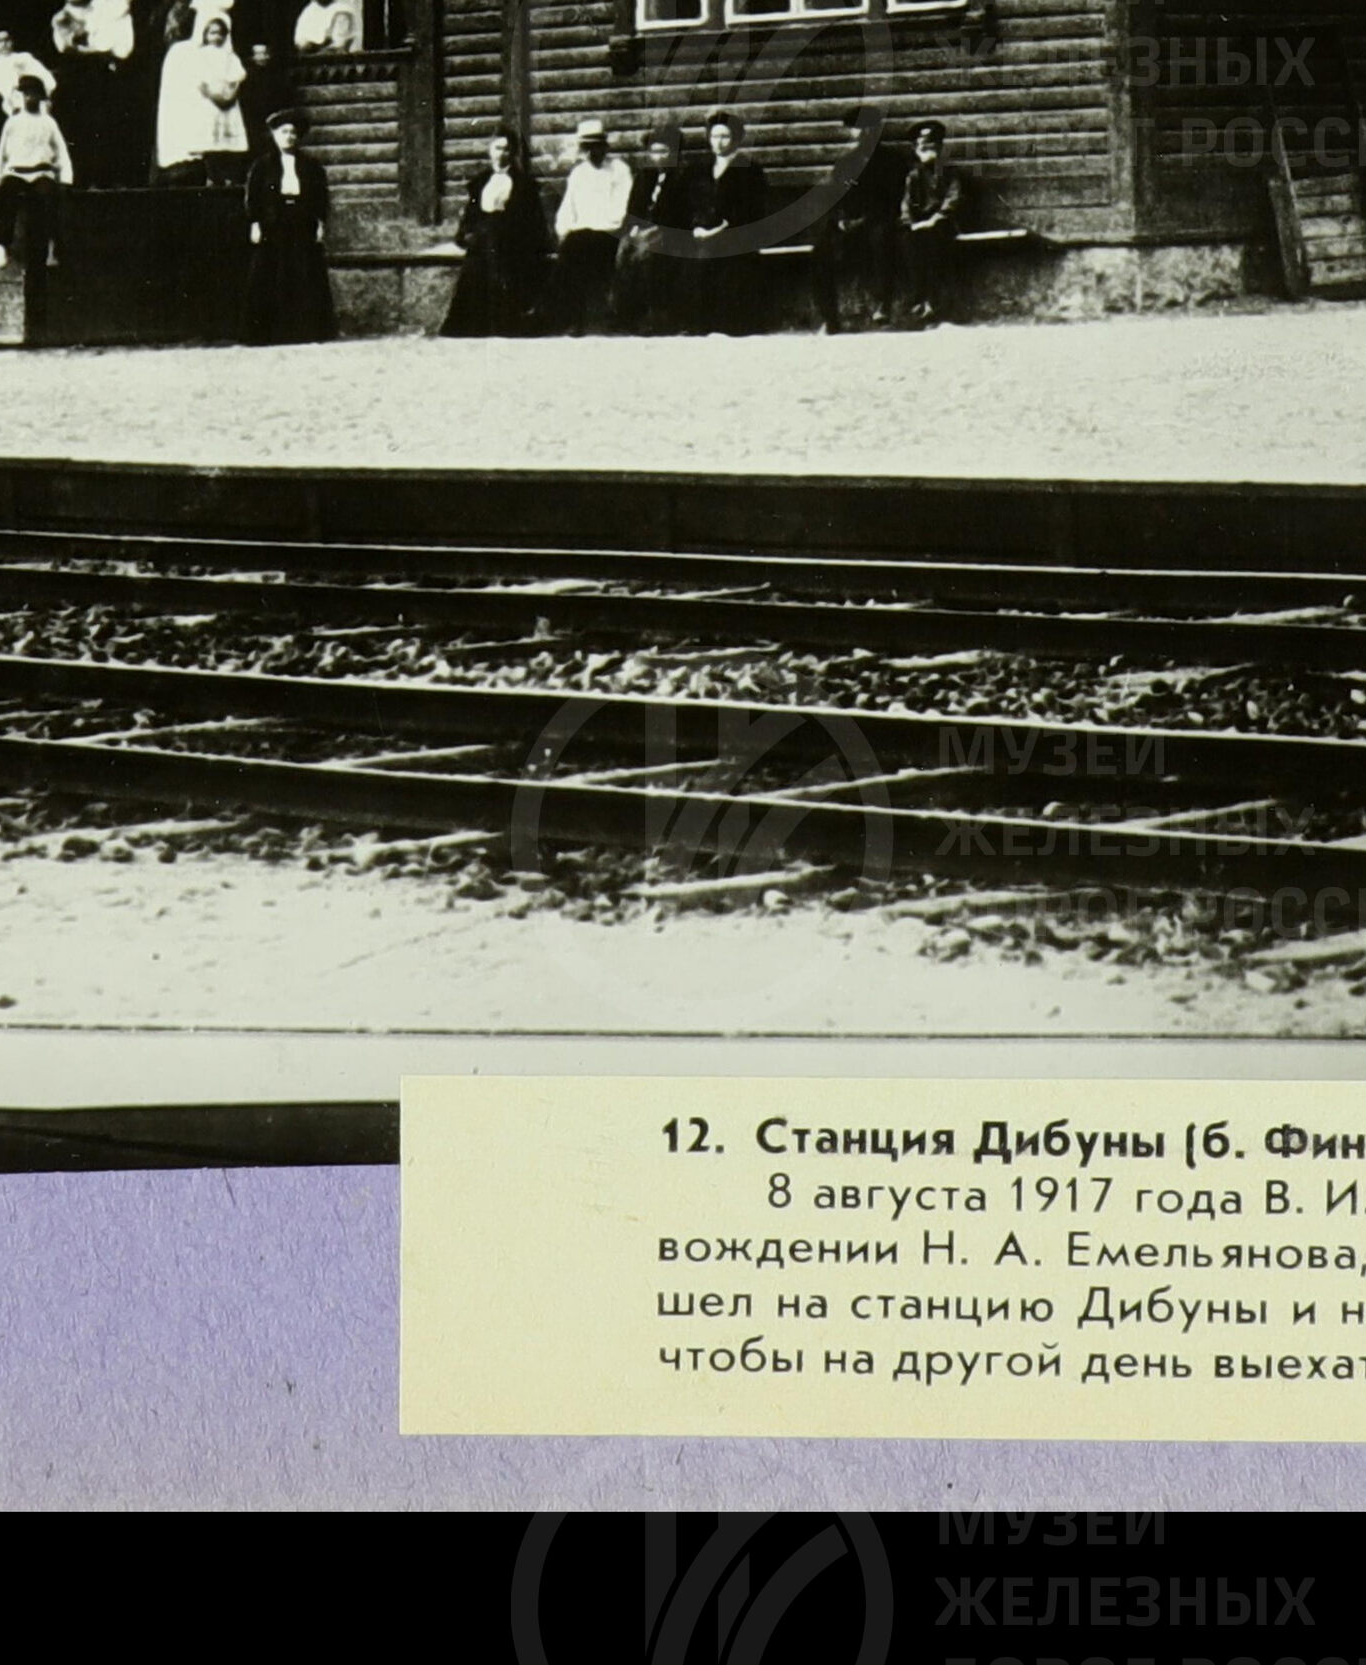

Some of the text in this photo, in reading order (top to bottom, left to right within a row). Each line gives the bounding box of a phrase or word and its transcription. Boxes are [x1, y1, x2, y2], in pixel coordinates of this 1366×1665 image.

[662, 1117, 724, 1154] 12.
[756, 1117, 955, 1163] Станция
[973, 1118, 1165, 1168] Дибуны
[1185, 1120, 1245, 1170] (б.
[768, 1172, 792, 1209] 8
[813, 1185, 986, 1221] августа
[1012, 1176, 1112, 1212] 1917
[1136, 1189, 1242, 1220] года
[1265, 1179, 1303, 1214] В.
[658, 1238, 898, 1269] вождении
[923, 1230, 967, 1264] Н.
[994, 1231, 1041, 1266] А.
[657, 1293, 752, 1317] шел
[778, 1295, 828, 1319] на
[851, 1295, 1054, 1327] станцию
[1077, 1285, 1267, 1333] Дибуны
[1293, 1302, 1316, 1324] и
[659, 1335, 803, 1373] чтобы
[824, 1350, 874, 1374] на
[892, 1344, 1061, 1386] другой
[1081, 1353, 1192, 1383] день
